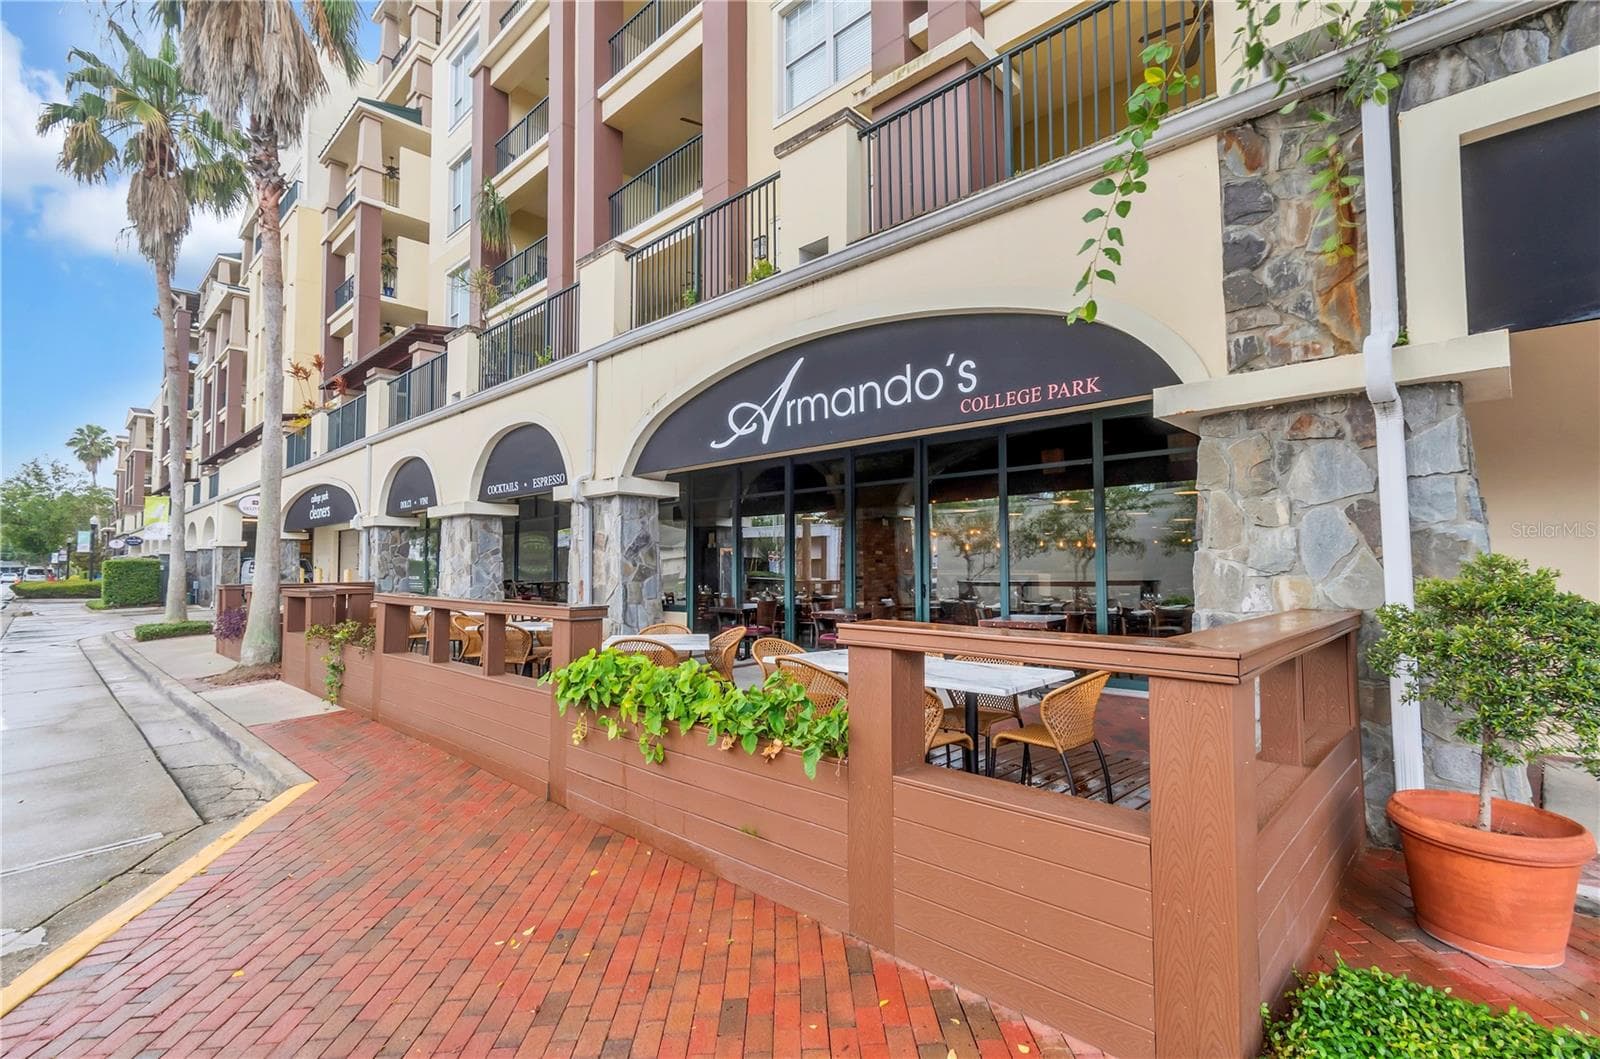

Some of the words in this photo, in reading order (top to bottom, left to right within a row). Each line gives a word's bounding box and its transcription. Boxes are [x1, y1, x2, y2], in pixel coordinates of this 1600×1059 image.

[711, 354, 978, 449] Armando's
[959, 386, 1042, 415] COLLEGE
[1047, 376, 1102, 400] PARK
[487, 481, 519, 495] COCKTAILS
[532, 473, 566, 489] ESPRESSO
[309, 504, 330, 520] cleaners
